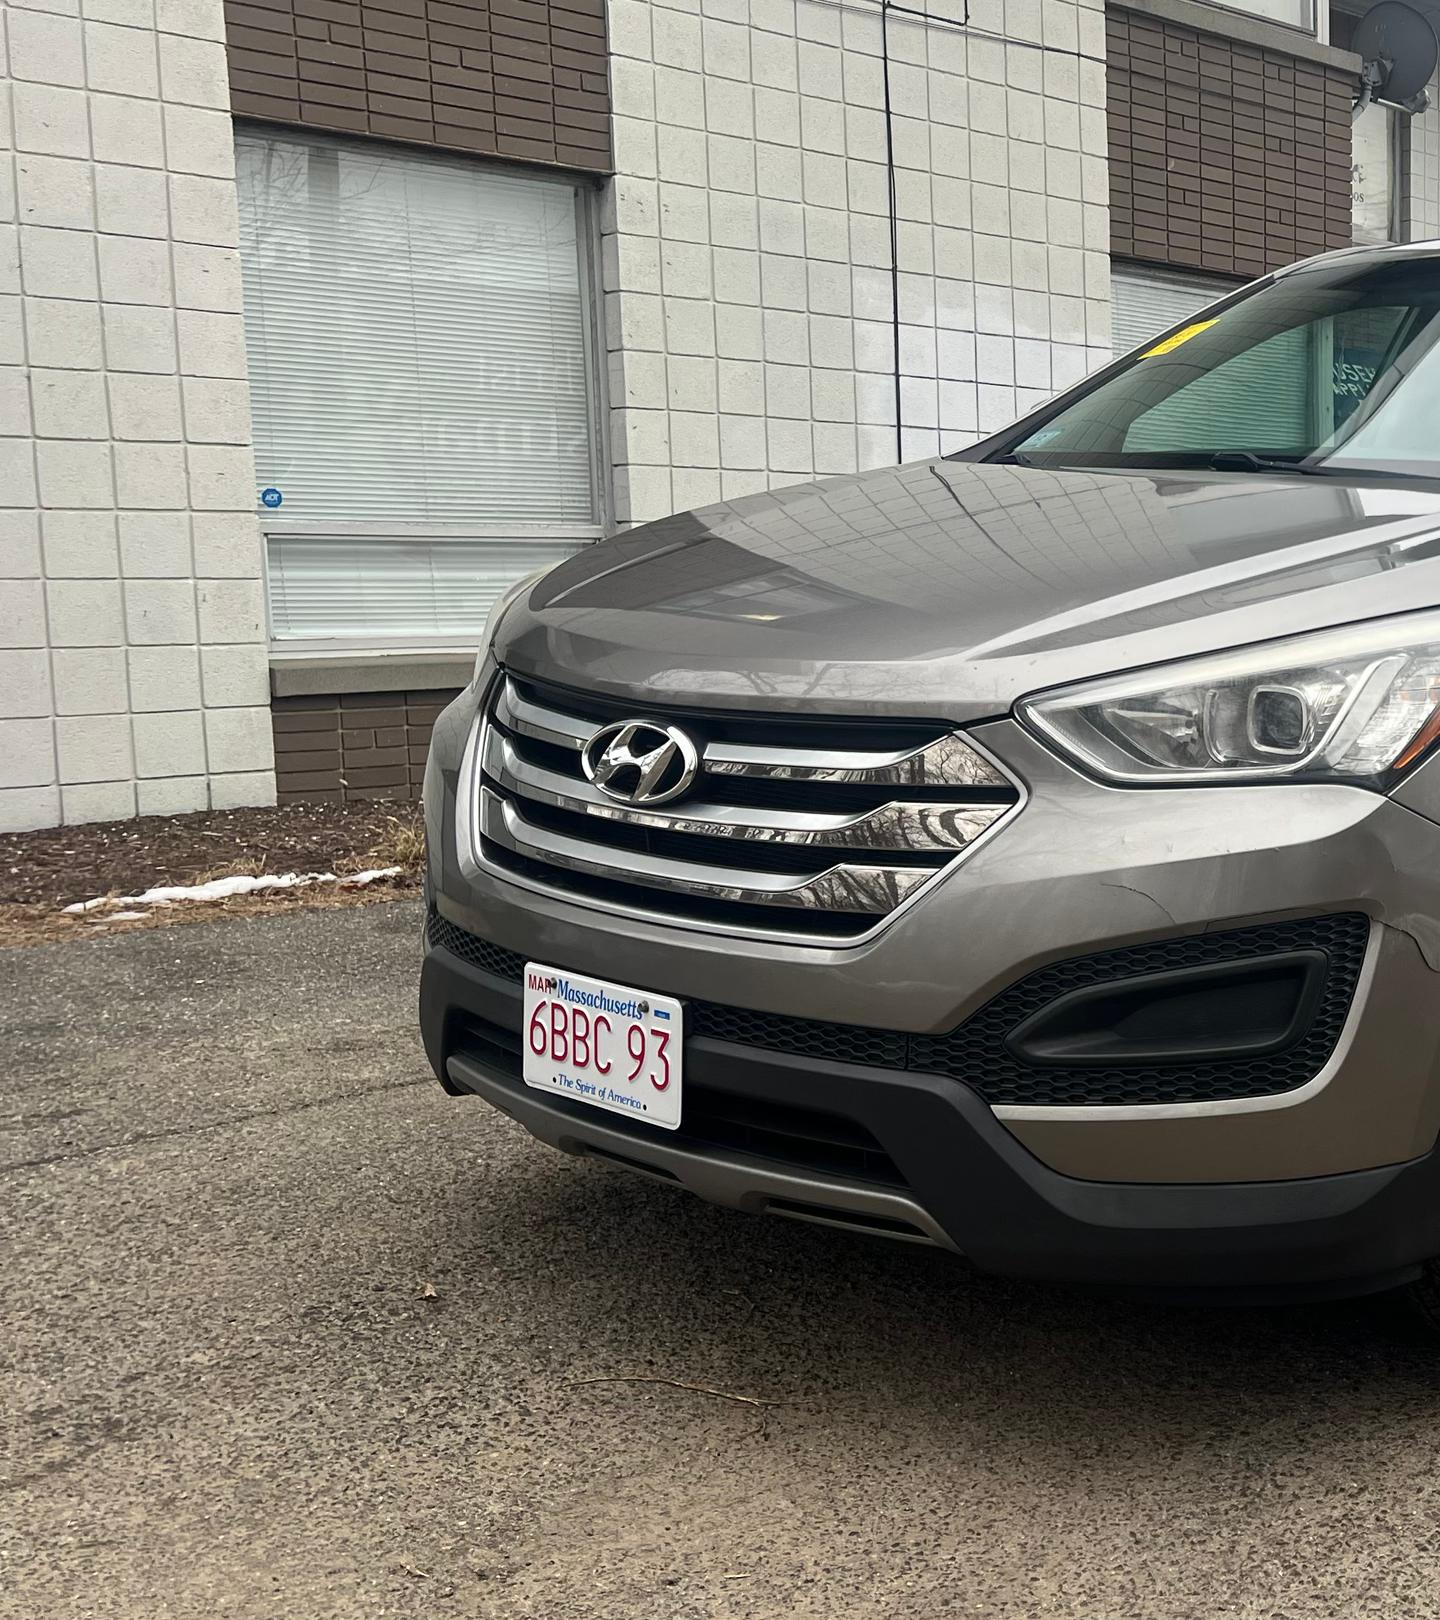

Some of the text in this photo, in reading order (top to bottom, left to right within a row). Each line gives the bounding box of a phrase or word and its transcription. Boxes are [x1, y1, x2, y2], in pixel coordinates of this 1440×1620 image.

[528, 973, 553, 995] MAR
[557, 978, 644, 1021] Massachusetts
[529, 1000, 672, 1092] 6BBC 93
[558, 1073, 642, 1110] The Spirit of America
